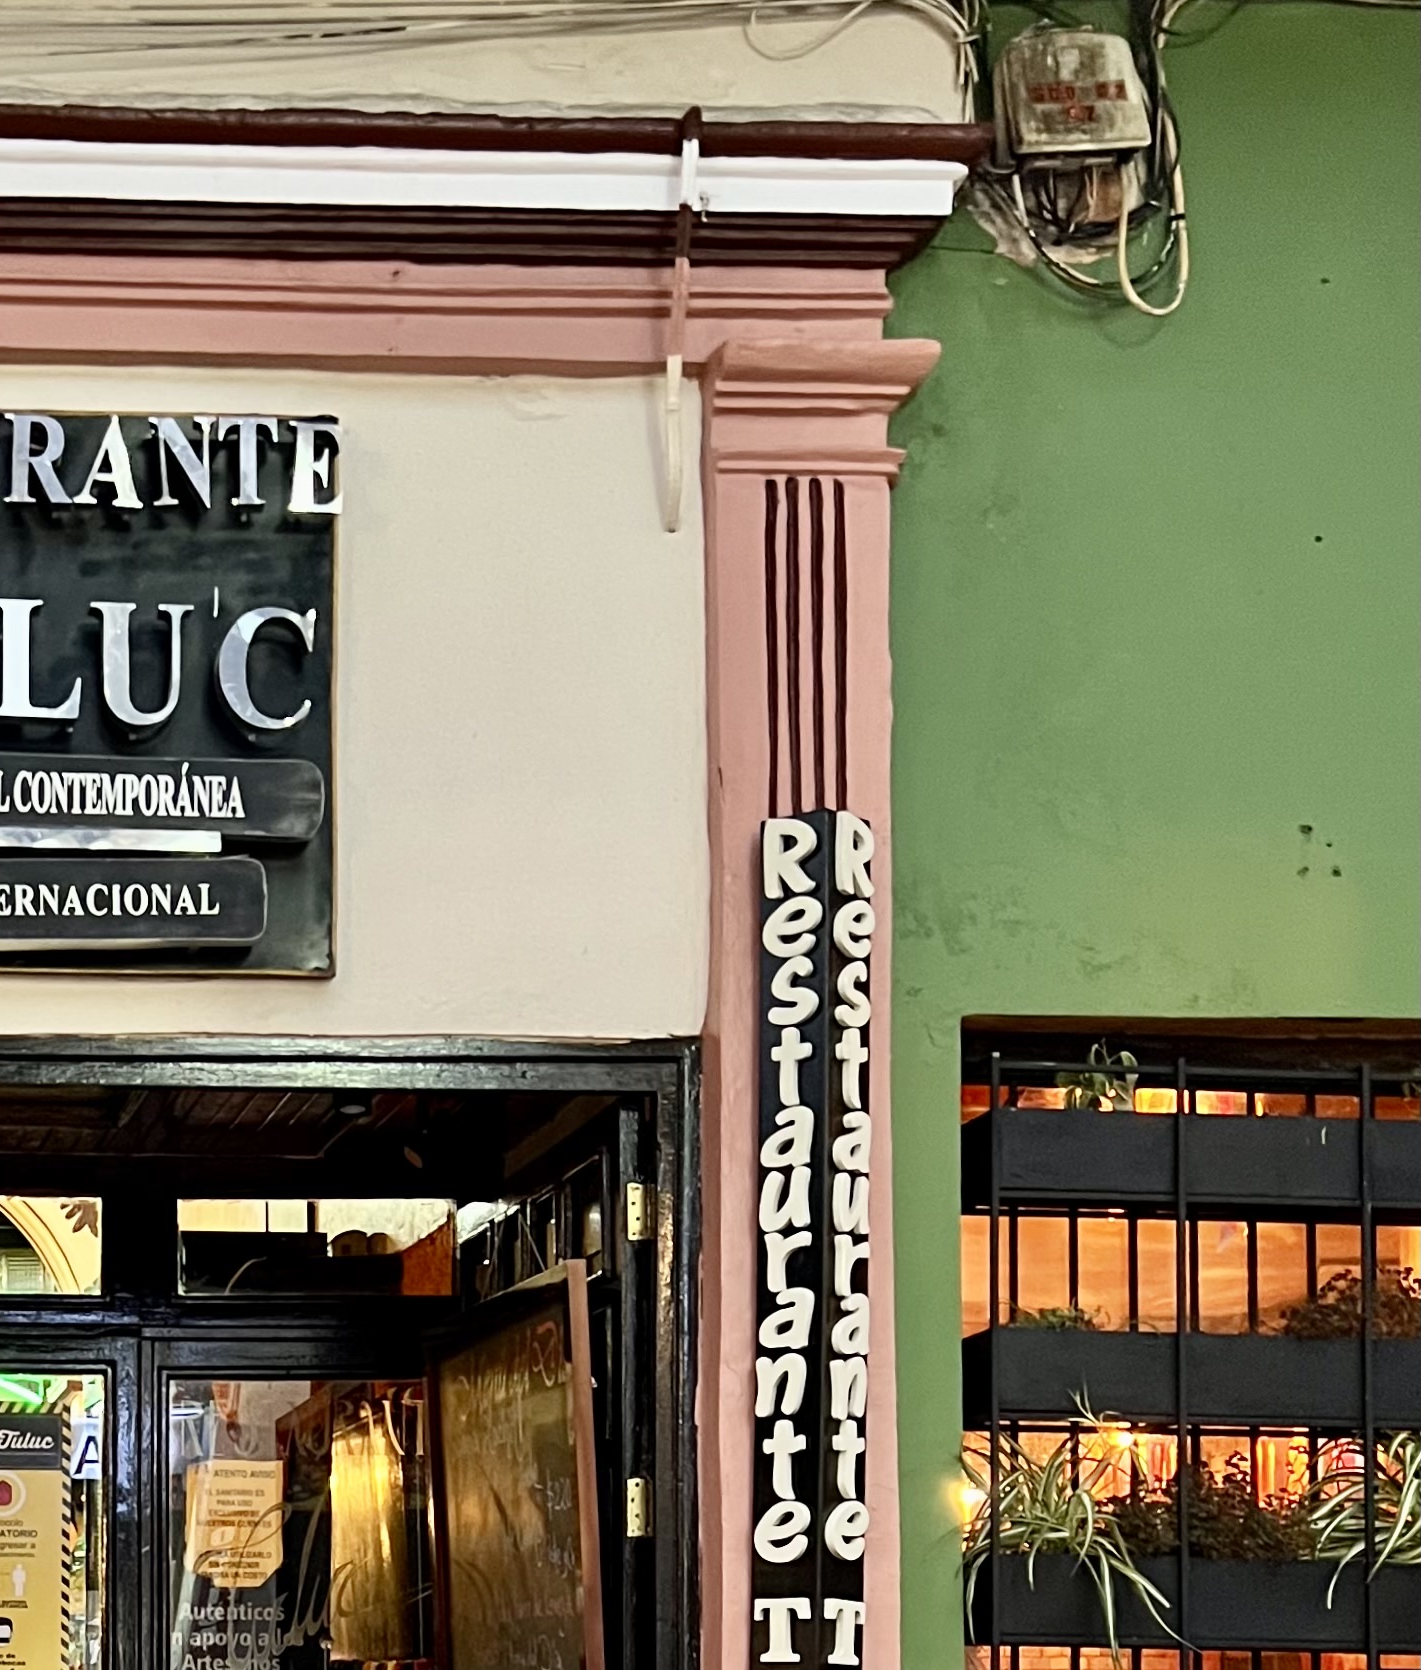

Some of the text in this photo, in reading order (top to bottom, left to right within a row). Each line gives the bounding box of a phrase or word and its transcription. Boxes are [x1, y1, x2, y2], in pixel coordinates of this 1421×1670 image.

[12, 761, 246, 818] CONTEMPORÁNEA
[752, 817, 824, 1564] Restaurante
[823, 810, 876, 1561] Restaurante
